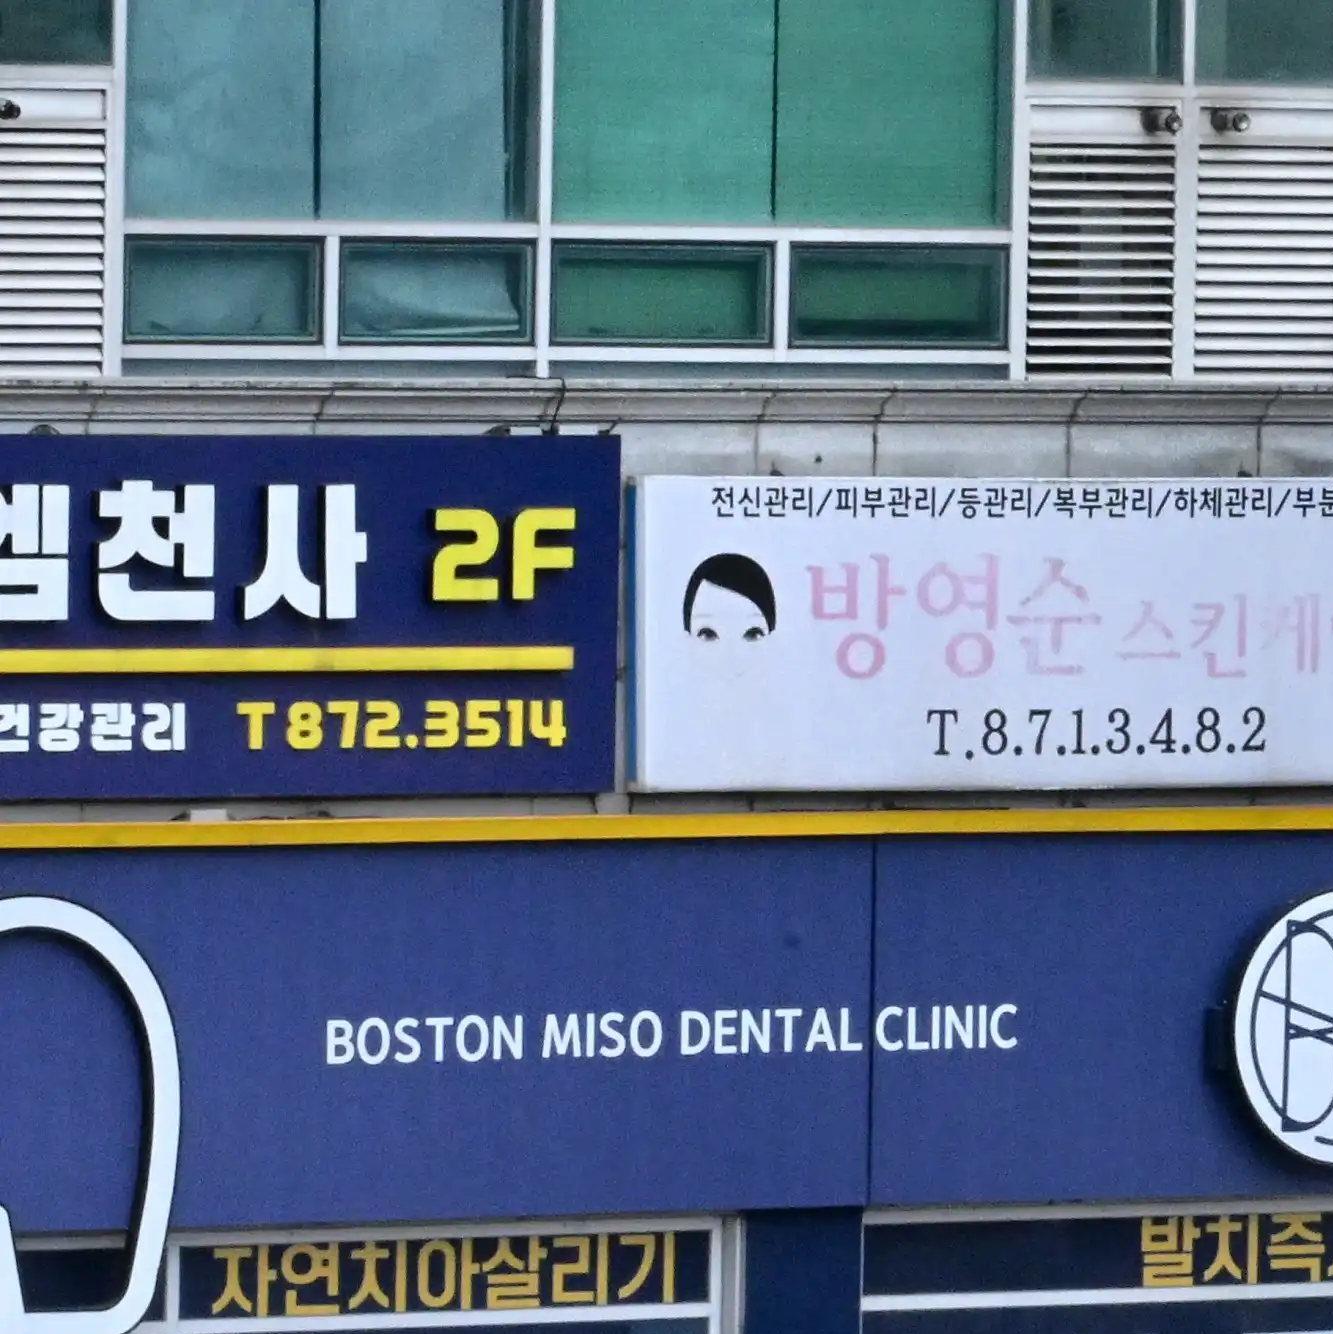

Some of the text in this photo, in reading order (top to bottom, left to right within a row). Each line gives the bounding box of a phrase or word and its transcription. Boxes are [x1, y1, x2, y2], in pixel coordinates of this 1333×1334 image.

[432, 507, 577, 602] 2F
[805, 551, 1102, 681] 방영순
[287, 698, 567, 751] 872.3514
[925, 706, 1268, 762] T.8.7.1.3.4.8.2
[325, 1003, 1019, 1067] BOSTON MISO DENTAL CLINIC
[210, 1232, 679, 1318] 자연치아살리기
